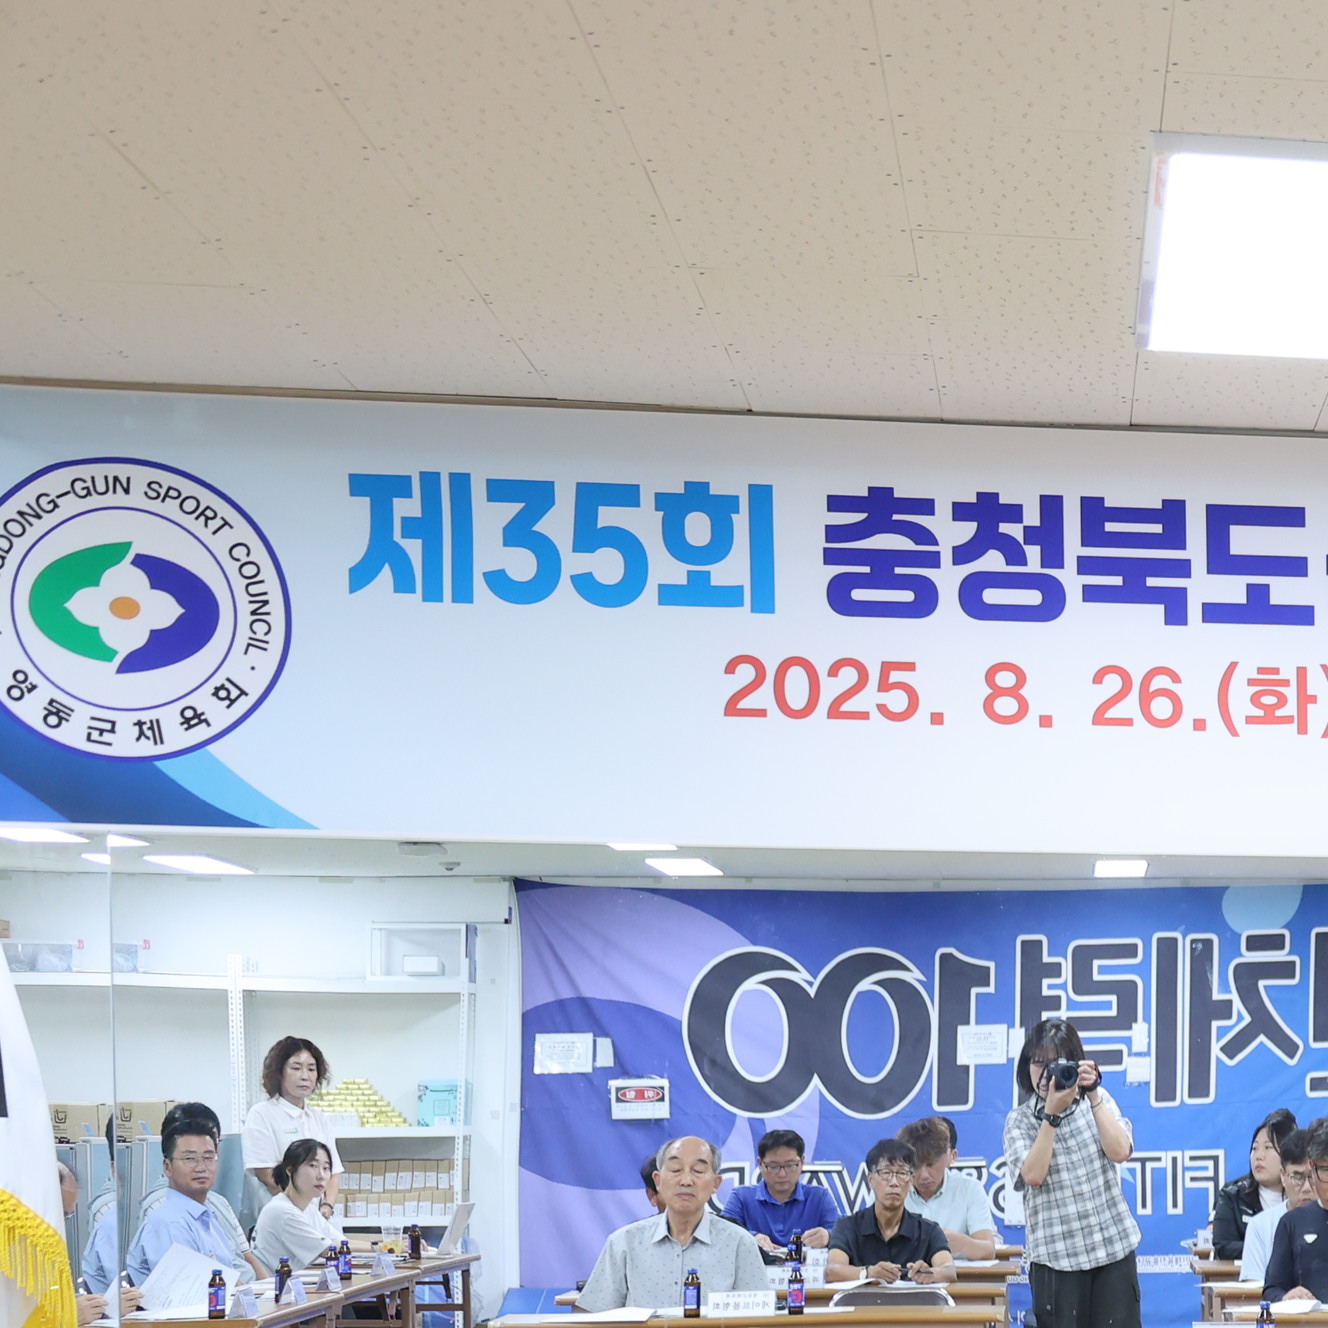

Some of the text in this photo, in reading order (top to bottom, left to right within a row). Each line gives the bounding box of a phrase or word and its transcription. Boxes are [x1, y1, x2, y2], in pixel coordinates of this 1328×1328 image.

[143, 480, 234, 537] SPORT
[228, 541, 272, 656] COUNCIL
[347, 470, 776, 615] 제35회
[723, 653, 945, 726] 2025.
[981, 661, 1053, 729] 8.
